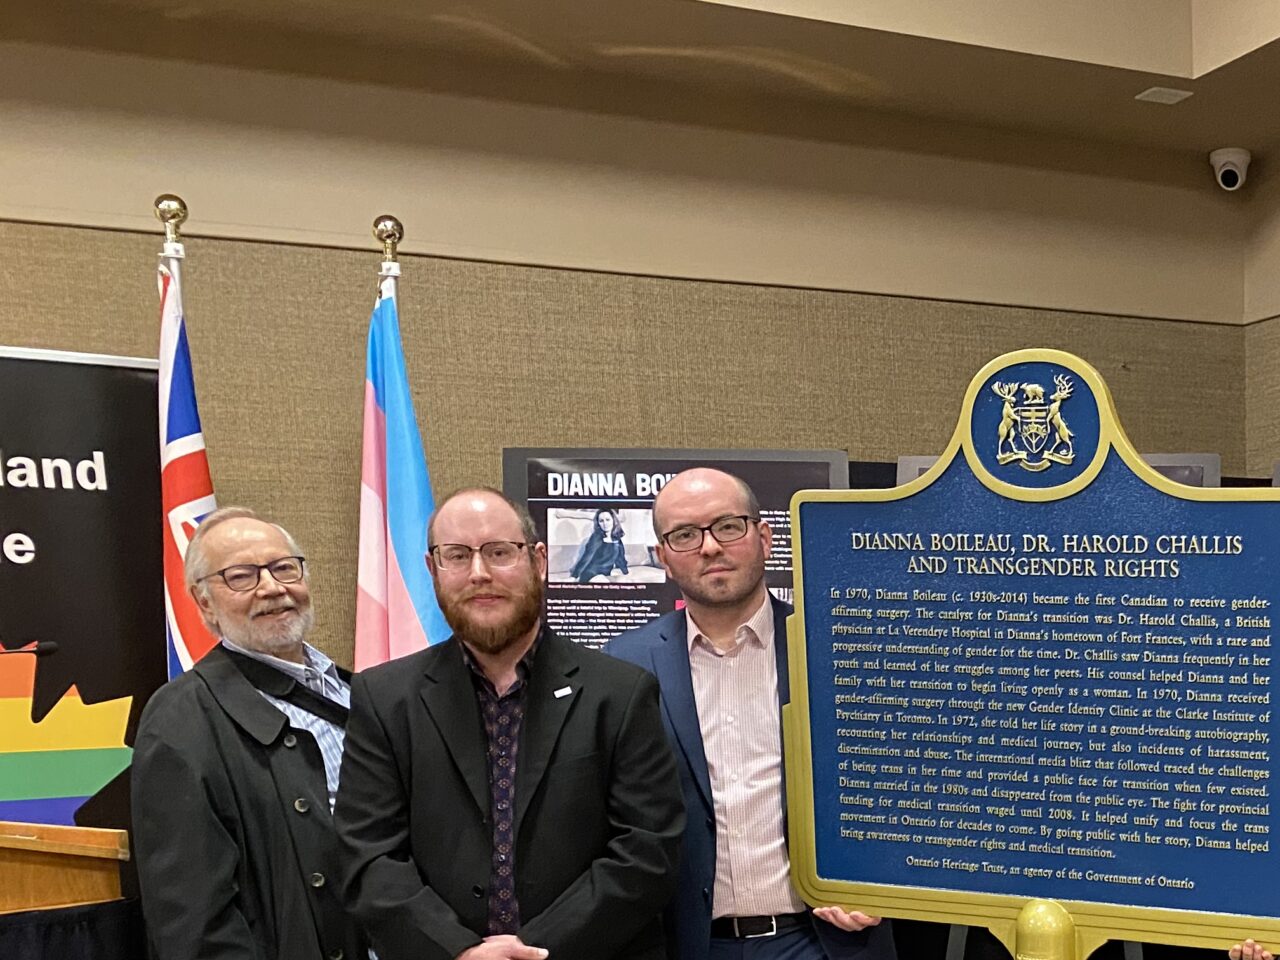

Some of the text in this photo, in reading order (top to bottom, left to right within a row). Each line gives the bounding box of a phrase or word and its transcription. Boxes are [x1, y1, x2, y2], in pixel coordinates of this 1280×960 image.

[548, 473, 628, 496] DIANNA
[851, 531, 1243, 556] DIANNA BOILEAU, DR. HAROLD CHALLIS
[906, 555, 1179, 578] AND TRANSGENDER RIGHTS
[830, 586, 1271, 611] In 1970, Dianna Boileau (c. 1930s-2014) became the first Canadian to receive gender-
[831, 604, 1271, 629] affirming surgery. The catalyst for Dianna's transition was Dr. Harold Challis, a British
[831, 622, 1271, 647] physician at La Verendrye Hospital in Dianna's hometown of Fort Frances, with a rare and
[836, 728, 886, 740] recounting
[890, 728, 907, 740] her
[912, 730, 972, 745] relationships
[977, 734, 995, 745] and
[1000, 735, 1037, 748] medical
[1088, 739, 1106, 751] but
[1111, 740, 1131, 753] also
[1137, 742, 1184, 756] incidents
[1189, 744, 1202, 756] of
[837, 742, 901, 756] discrimination
[903, 747, 920, 758] and
[954, 749, 973, 761] The
[975, 751, 1034, 765] international
[1038, 755, 1066, 767] media
[1069, 756, 1091, 768] blitz
[1094, 757, 1114, 770] that
[1117, 759, 1160, 772] followed
[1163, 762, 1194, 774] traced
[1198, 763, 1214, 775] the
[1217, 764, 1270, 781] challenges
[839, 776, 870, 788] Dianna
[873, 780, 908, 791] married
[923, 782, 938, 793] the
[942, 783, 968, 795] 1980s
[971, 785, 988, 797] and
[991, 786, 1046, 801] disappeared
[1049, 790, 1072, 802] from
[1075, 791, 1091, 804] the
[1094, 793, 1124, 807] public
[1149, 796, 1170, 809] The
[1173, 797, 1197, 813] fight
[1199, 799, 1216, 812] for
[1218, 802, 1269, 816] provincial
[840, 826, 864, 841] bring
[866, 831, 910, 842] awareness
[912, 834, 922, 843] to
[924, 835, 978, 847] transgender
[980, 837, 1006, 851] rights
[1008, 840, 1026, 851] and
[1028, 841, 1064, 854] medical
[905, 855, 1194, 889] Ontario Heritage Trust, an agency of the Government of Ontario
